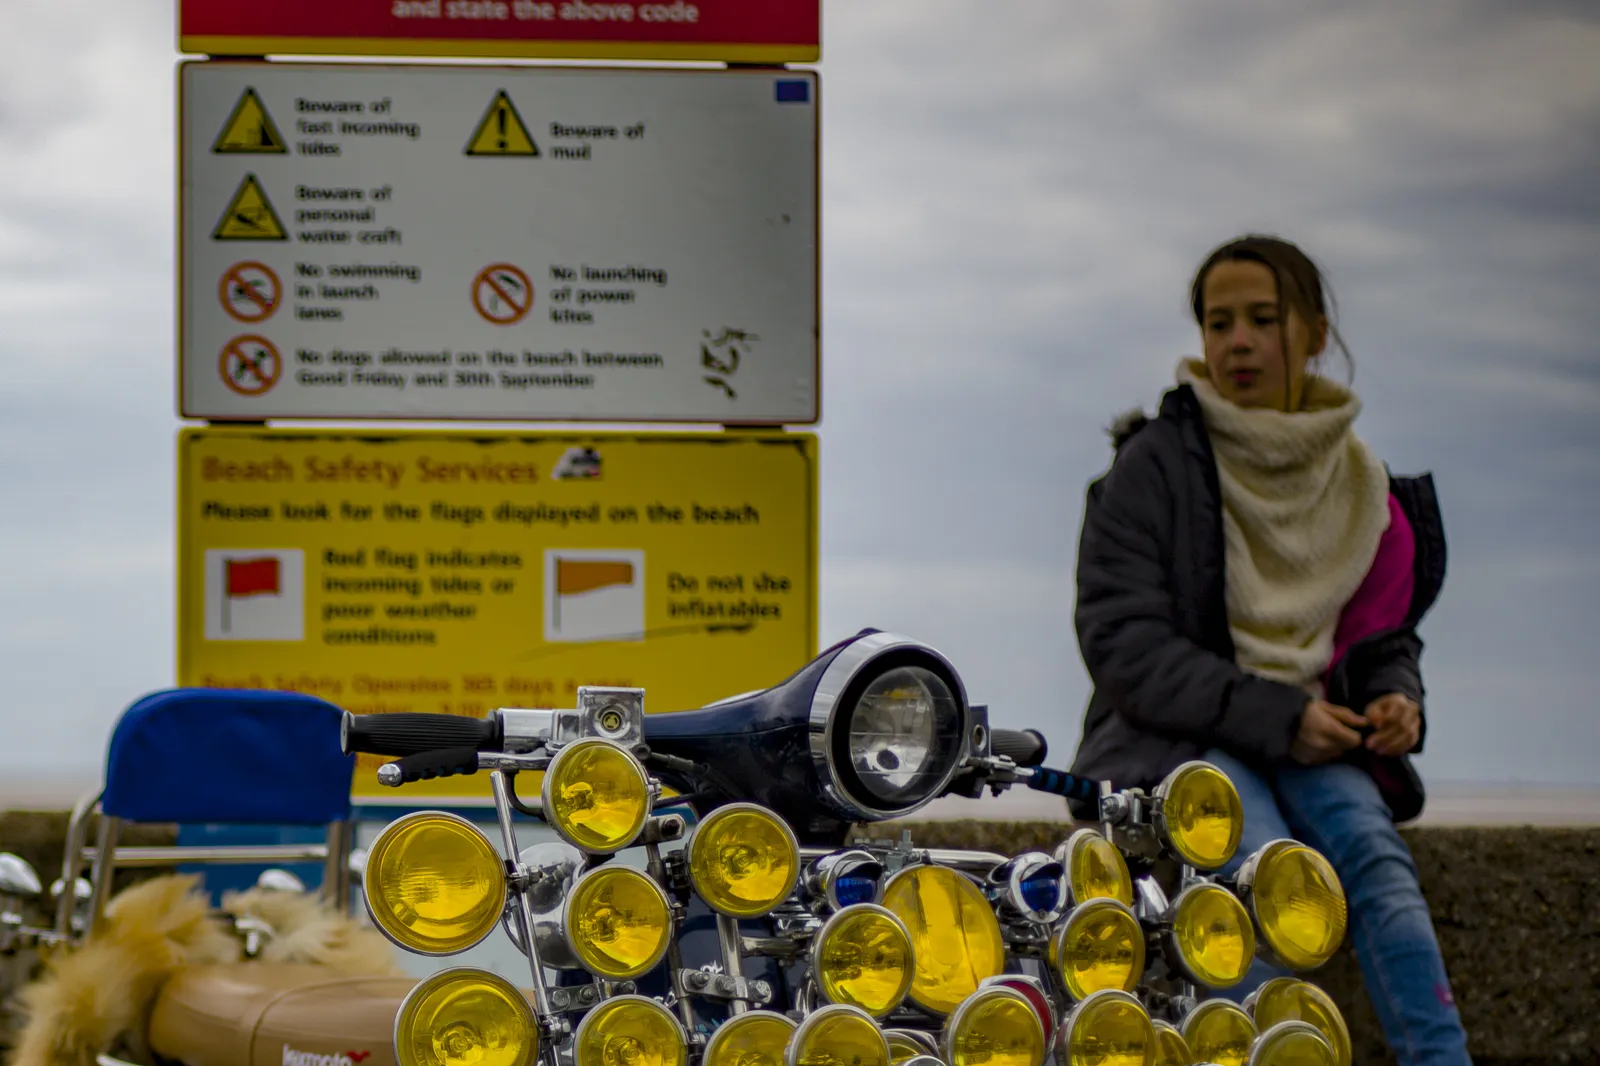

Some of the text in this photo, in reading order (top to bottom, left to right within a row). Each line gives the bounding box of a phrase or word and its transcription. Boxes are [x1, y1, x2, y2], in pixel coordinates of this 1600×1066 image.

[392, 0, 699, 23] and state the above code
[296, 97, 391, 113] Beware of
[338, 119, 420, 139] incoming
[550, 121, 645, 140] Beware of
[550, 141, 591, 160] mud
[296, 184, 391, 200] Beware of
[296, 205, 375, 223] personal
[357, 227, 401, 244] craft
[295, 262, 422, 283] No swimming
[550, 264, 667, 287] No launching
[295, 283, 379, 300] in launch
[550, 284, 636, 306] of power
[295, 349, 323, 365] No
[378, 348, 452, 366] allowed
[487, 349, 517, 366] the
[523, 349, 578, 366] beach
[581, 350, 664, 368] between
[295, 369, 347, 387] Good
[352, 369, 408, 391] Friday
[501, 371, 594, 391] September
[201, 454, 539, 490] Beach Safety Services
[203, 500, 760, 528] Please look for the flags displayed on the beach
[323, 547, 524, 572] Red flag indicates
[322, 573, 423, 597] incoming
[667, 571, 699, 594] Do
[706, 574, 744, 594] not
[322, 600, 477, 623] poor weather
[666, 597, 782, 620] inflatables
[322, 623, 437, 646] conditions
